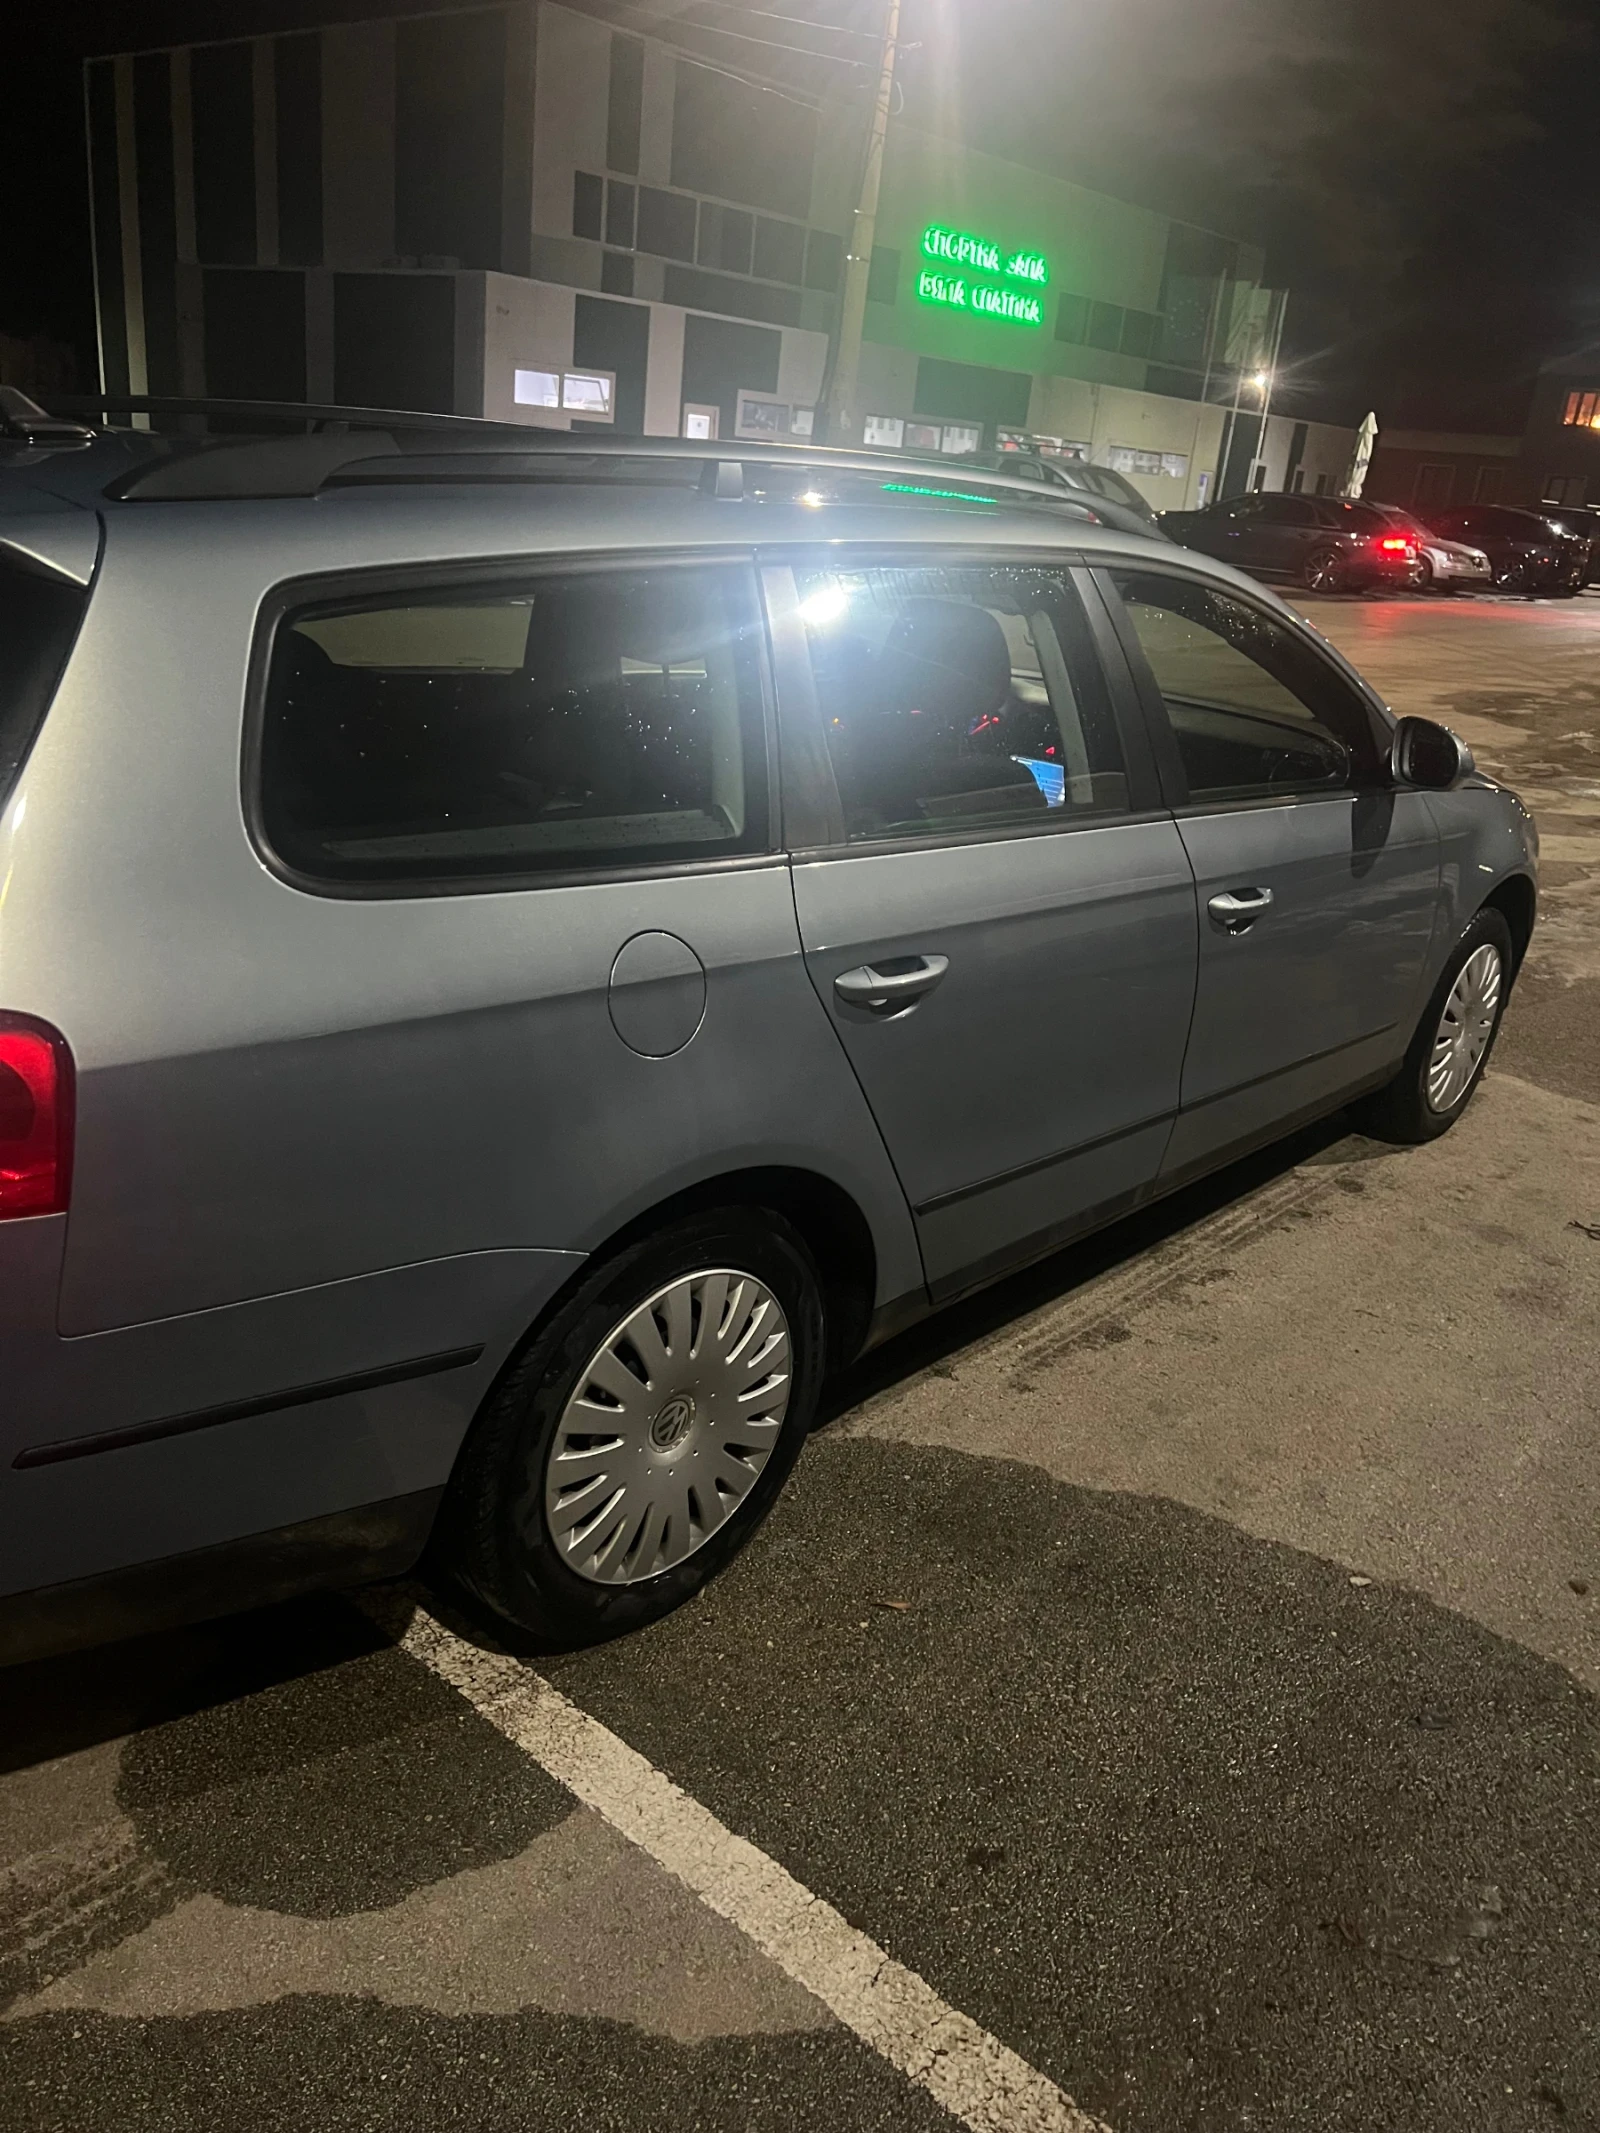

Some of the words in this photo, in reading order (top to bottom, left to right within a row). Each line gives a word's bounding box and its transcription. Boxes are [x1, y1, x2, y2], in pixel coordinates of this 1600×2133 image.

[922, 226, 1001, 272] СПОРТНА
[1004, 251, 1048, 284] ЗАЛА
[918, 270, 967, 307] БЯЛА
[971, 283, 1042, 324] СЛАТИНА
